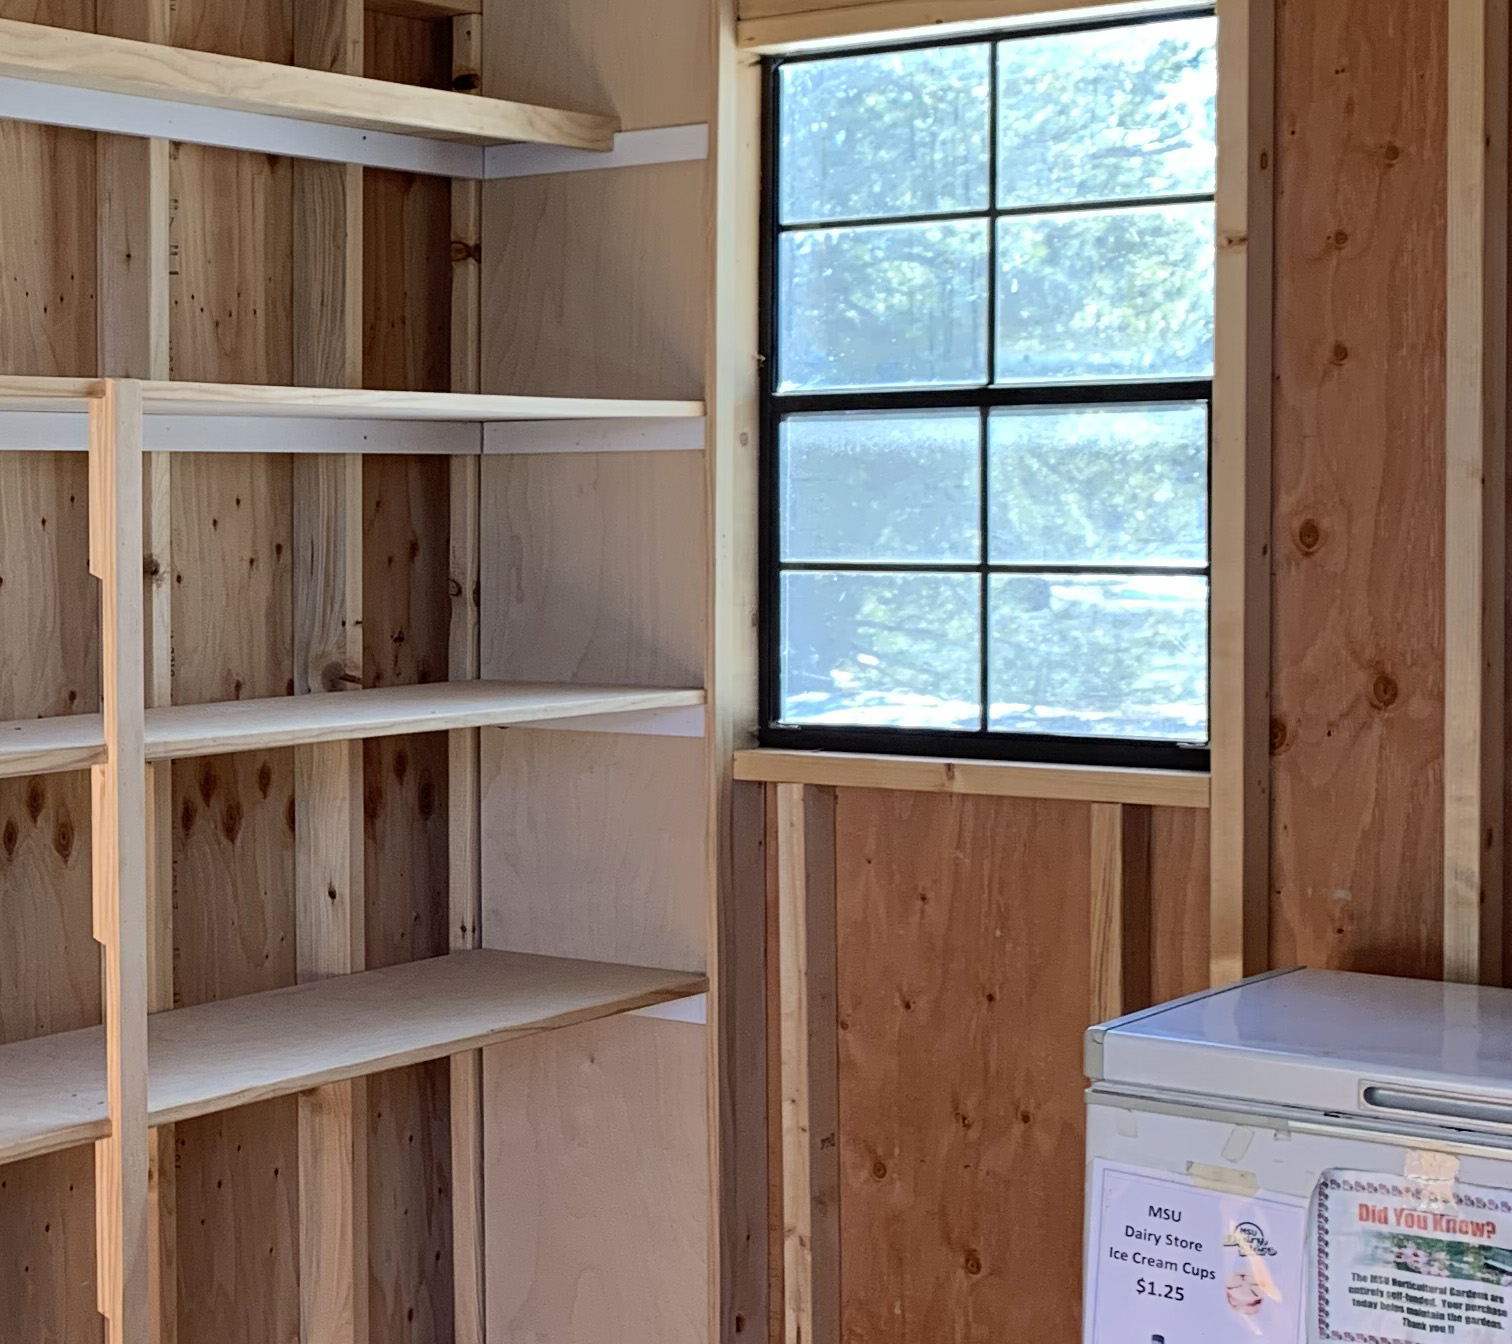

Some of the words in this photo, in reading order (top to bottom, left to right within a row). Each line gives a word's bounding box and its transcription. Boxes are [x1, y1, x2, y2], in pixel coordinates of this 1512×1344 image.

[1148, 1206, 1182, 1222] MSU
[1358, 1203, 1388, 1225] Did
[1394, 1208, 1428, 1231] You
[1433, 1213, 1496, 1239] Know?
[1125, 1225, 1161, 1246] Dairy
[1166, 1233, 1203, 1252] Store
[1109, 1247, 1128, 1261] Ice
[1132, 1252, 1178, 1272] Cream
[1182, 1262, 1216, 1281] Cups
[1136, 1277, 1185, 1302] $1.25
[1351, 1272, 1368, 1283] The
[1391, 1277, 1447, 1295] Horticultural
[1449, 1287, 1488, 1301] Gardens
[1490, 1294, 1504, 1304] are
[1348, 1286, 1384, 1298] entirely
[1442, 1299, 1462, 1310] Your
[1465, 1303, 1508, 1318] purchase
[1352, 1298, 1378, 1310] today
[1406, 1307, 1445, 1321] maintain
[1447, 1312, 1462, 1323] the
[1402, 1317, 1426, 1331] Thank
[1429, 1323, 1446, 1334] you
